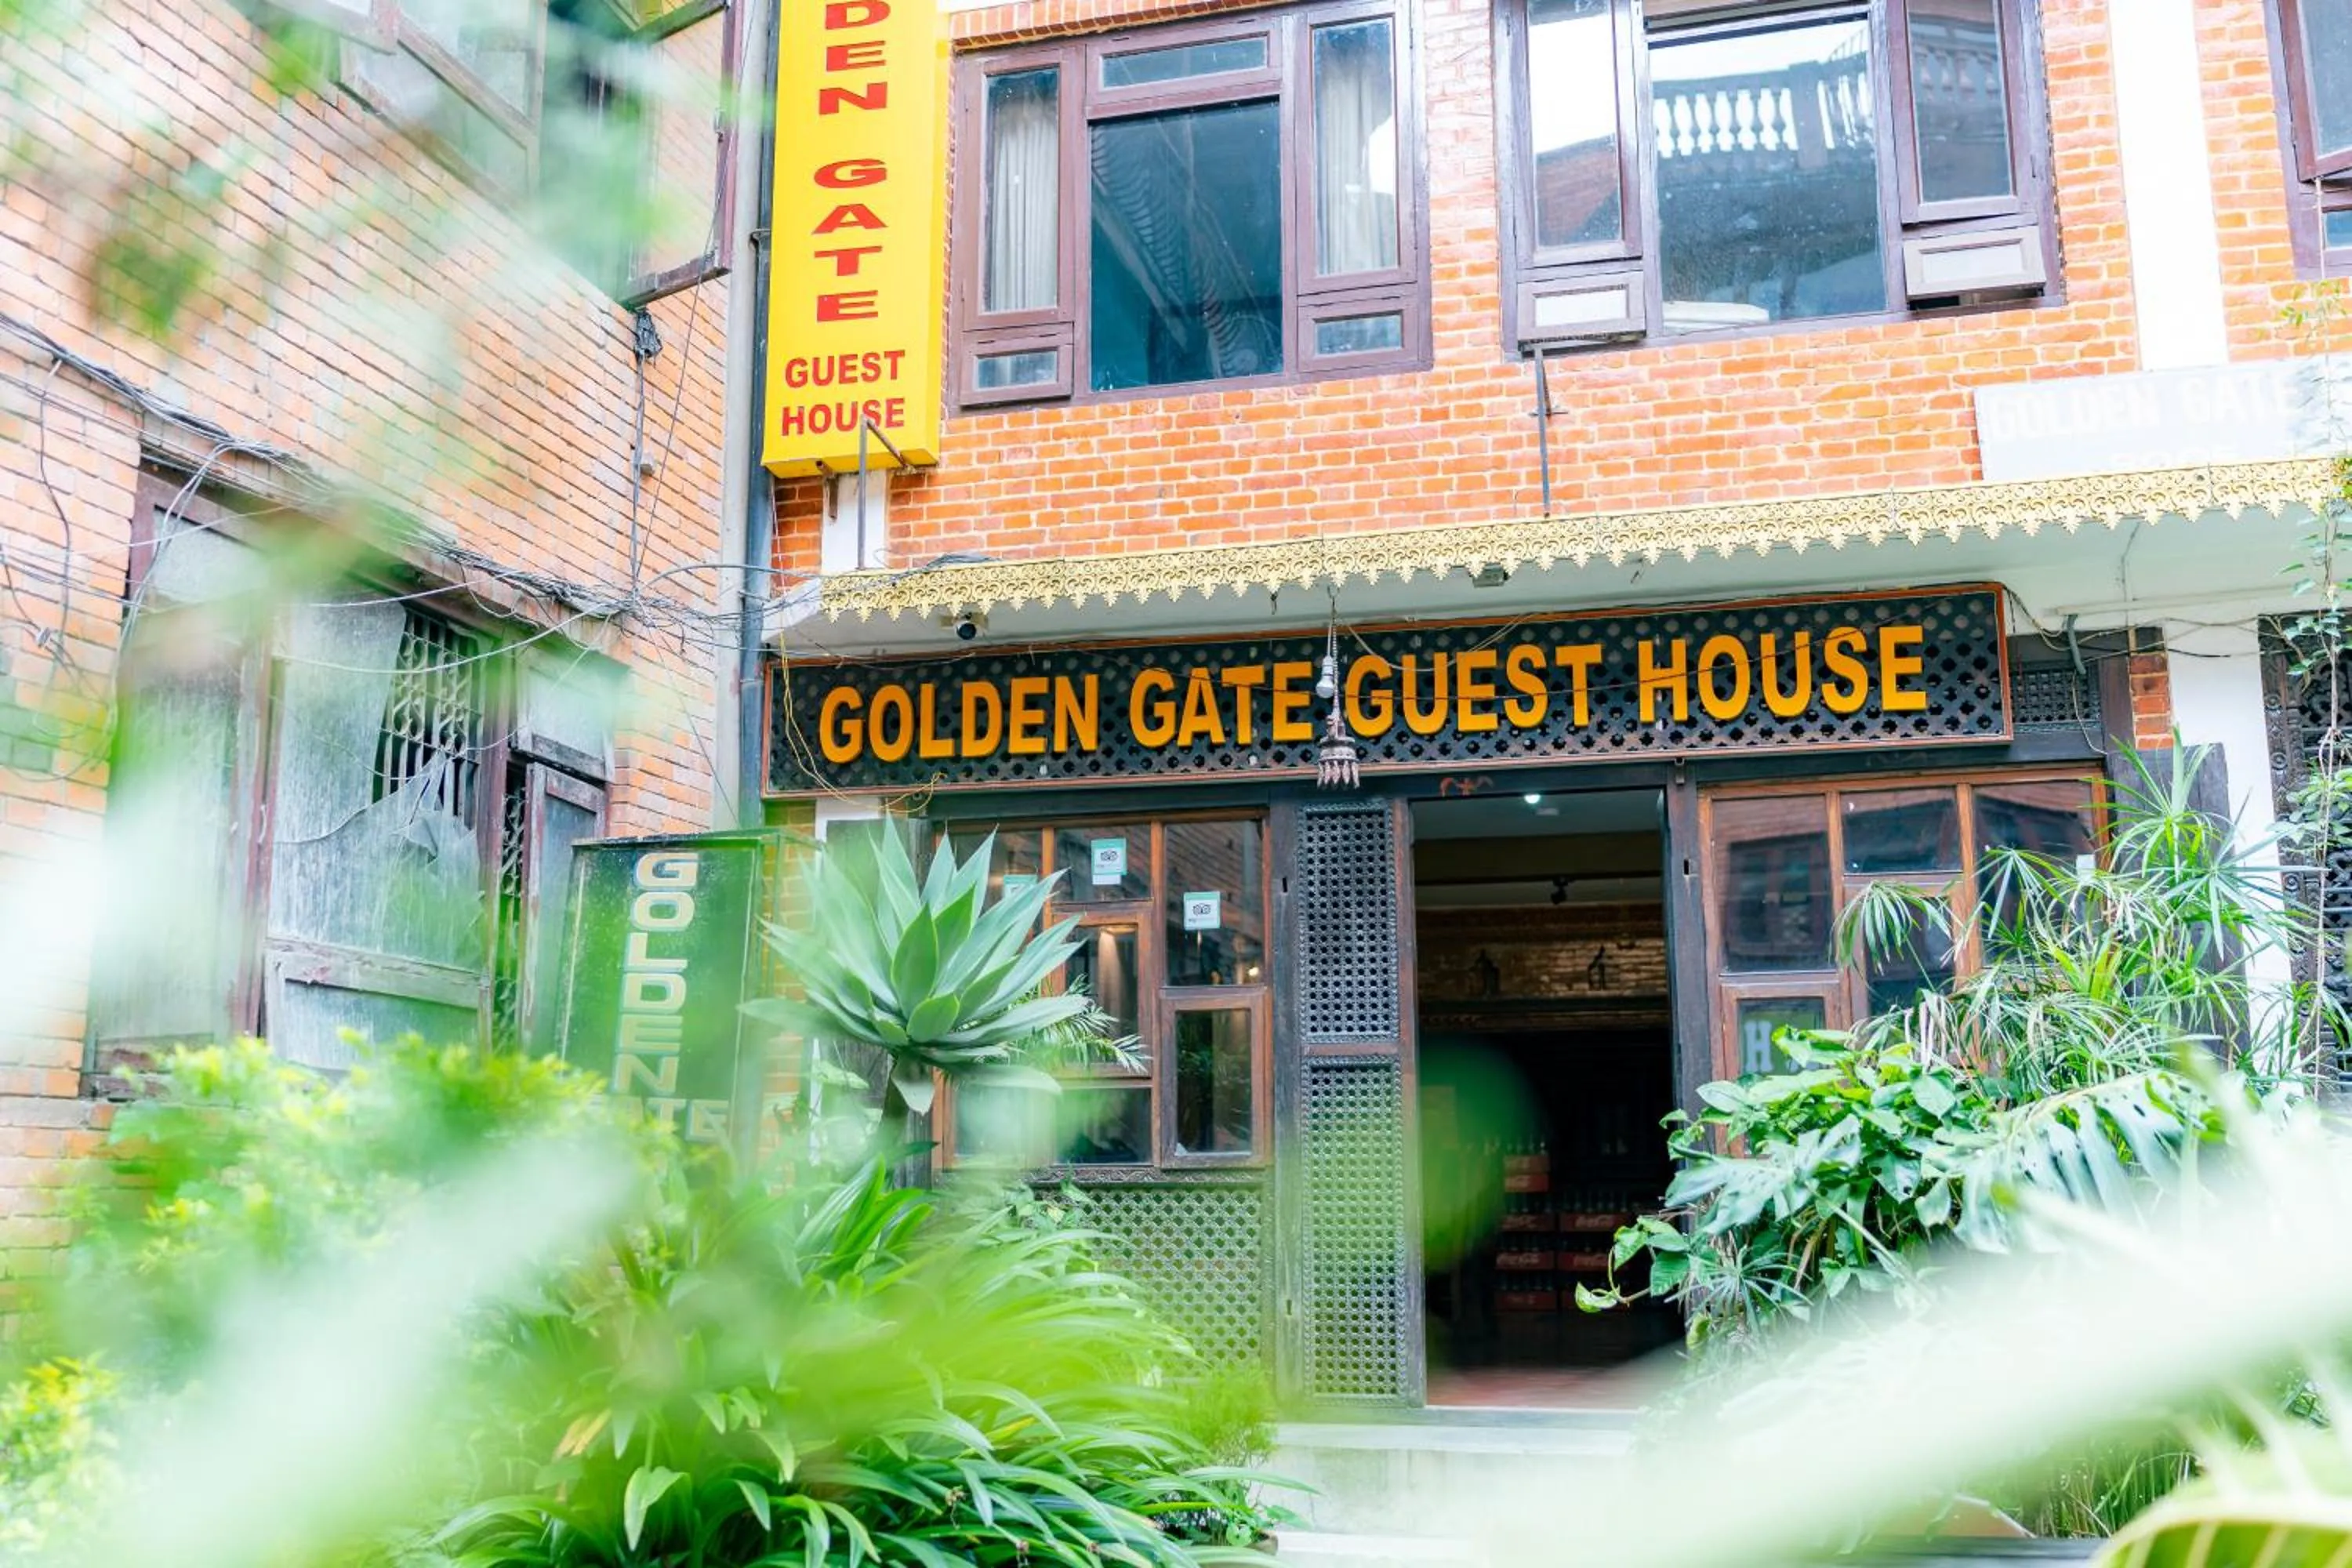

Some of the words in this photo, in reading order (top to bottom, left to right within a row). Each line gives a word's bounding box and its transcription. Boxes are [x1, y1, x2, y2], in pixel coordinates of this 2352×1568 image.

[811, 158, 888, 321] GATE
[781, 397, 906, 437] HOUSE
[785, 350, 906, 388] GUEST
[1989, 379, 2161, 442] GOLDEN
[818, 672, 1099, 764] GOLDEN
[1129, 660, 1314, 749] GATE
[1346, 643, 1602, 739] GUEST
[1637, 624, 1928, 723] HOUSE
[612, 851, 699, 1096] GOLDEN
